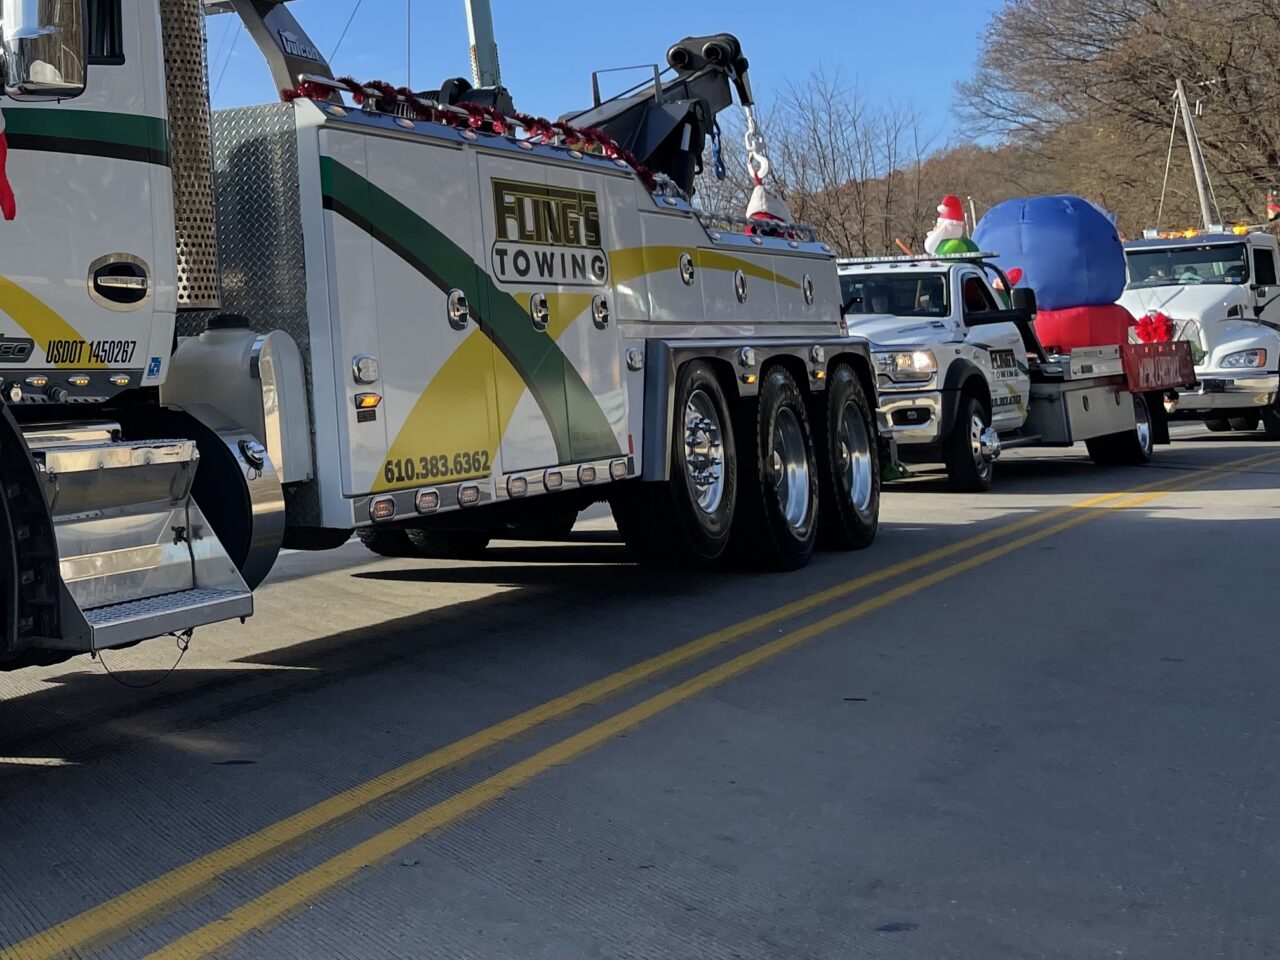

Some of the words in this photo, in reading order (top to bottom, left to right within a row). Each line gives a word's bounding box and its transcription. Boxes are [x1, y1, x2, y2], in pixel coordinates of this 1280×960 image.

[277, 29, 320, 61] Vulcan
[494, 247, 606, 281] TOWING
[45, 340, 86, 364] USDOT
[87, 340, 137, 364] 1450267
[992, 369, 1019, 379] TOWING
[384, 450, 491, 484] 610.383.6362
